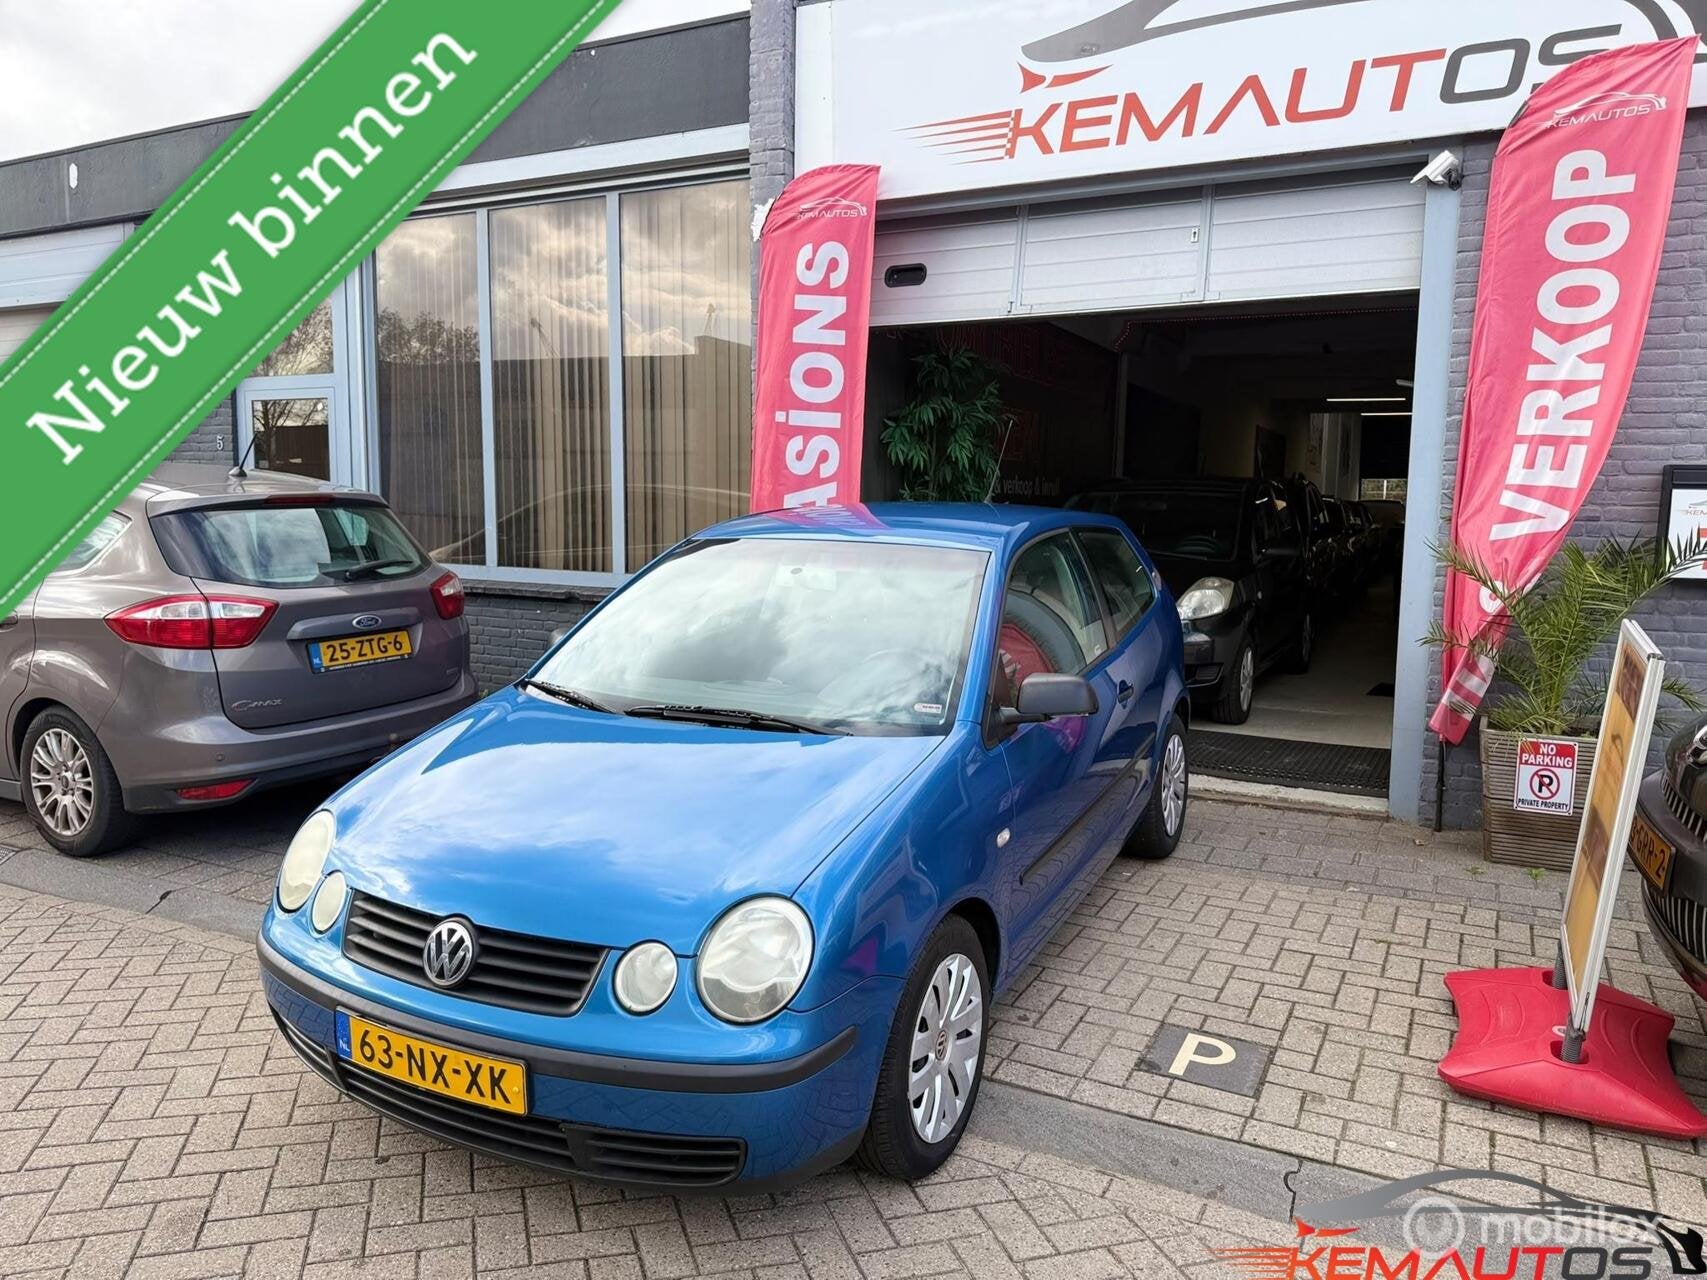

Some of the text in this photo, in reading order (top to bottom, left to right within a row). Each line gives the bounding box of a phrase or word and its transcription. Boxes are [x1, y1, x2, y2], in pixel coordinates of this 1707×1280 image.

[1544, 104, 1651, 128] KEMAUTOS
[1488, 149, 1637, 542] VERKOOP
[326, 635, 403, 663] 25-ZTG-6
[1540, 743, 1557, 755] NO
[1522, 753, 1573, 768] PARKING
[1538, 774, 1554, 793] P
[1518, 798, 1568, 811] PRIVATE PROPERTY
[338, 1037, 350, 1052] NL
[1168, 1032, 1237, 1076] P
[359, 1029, 512, 1105] 63-NX-XK
